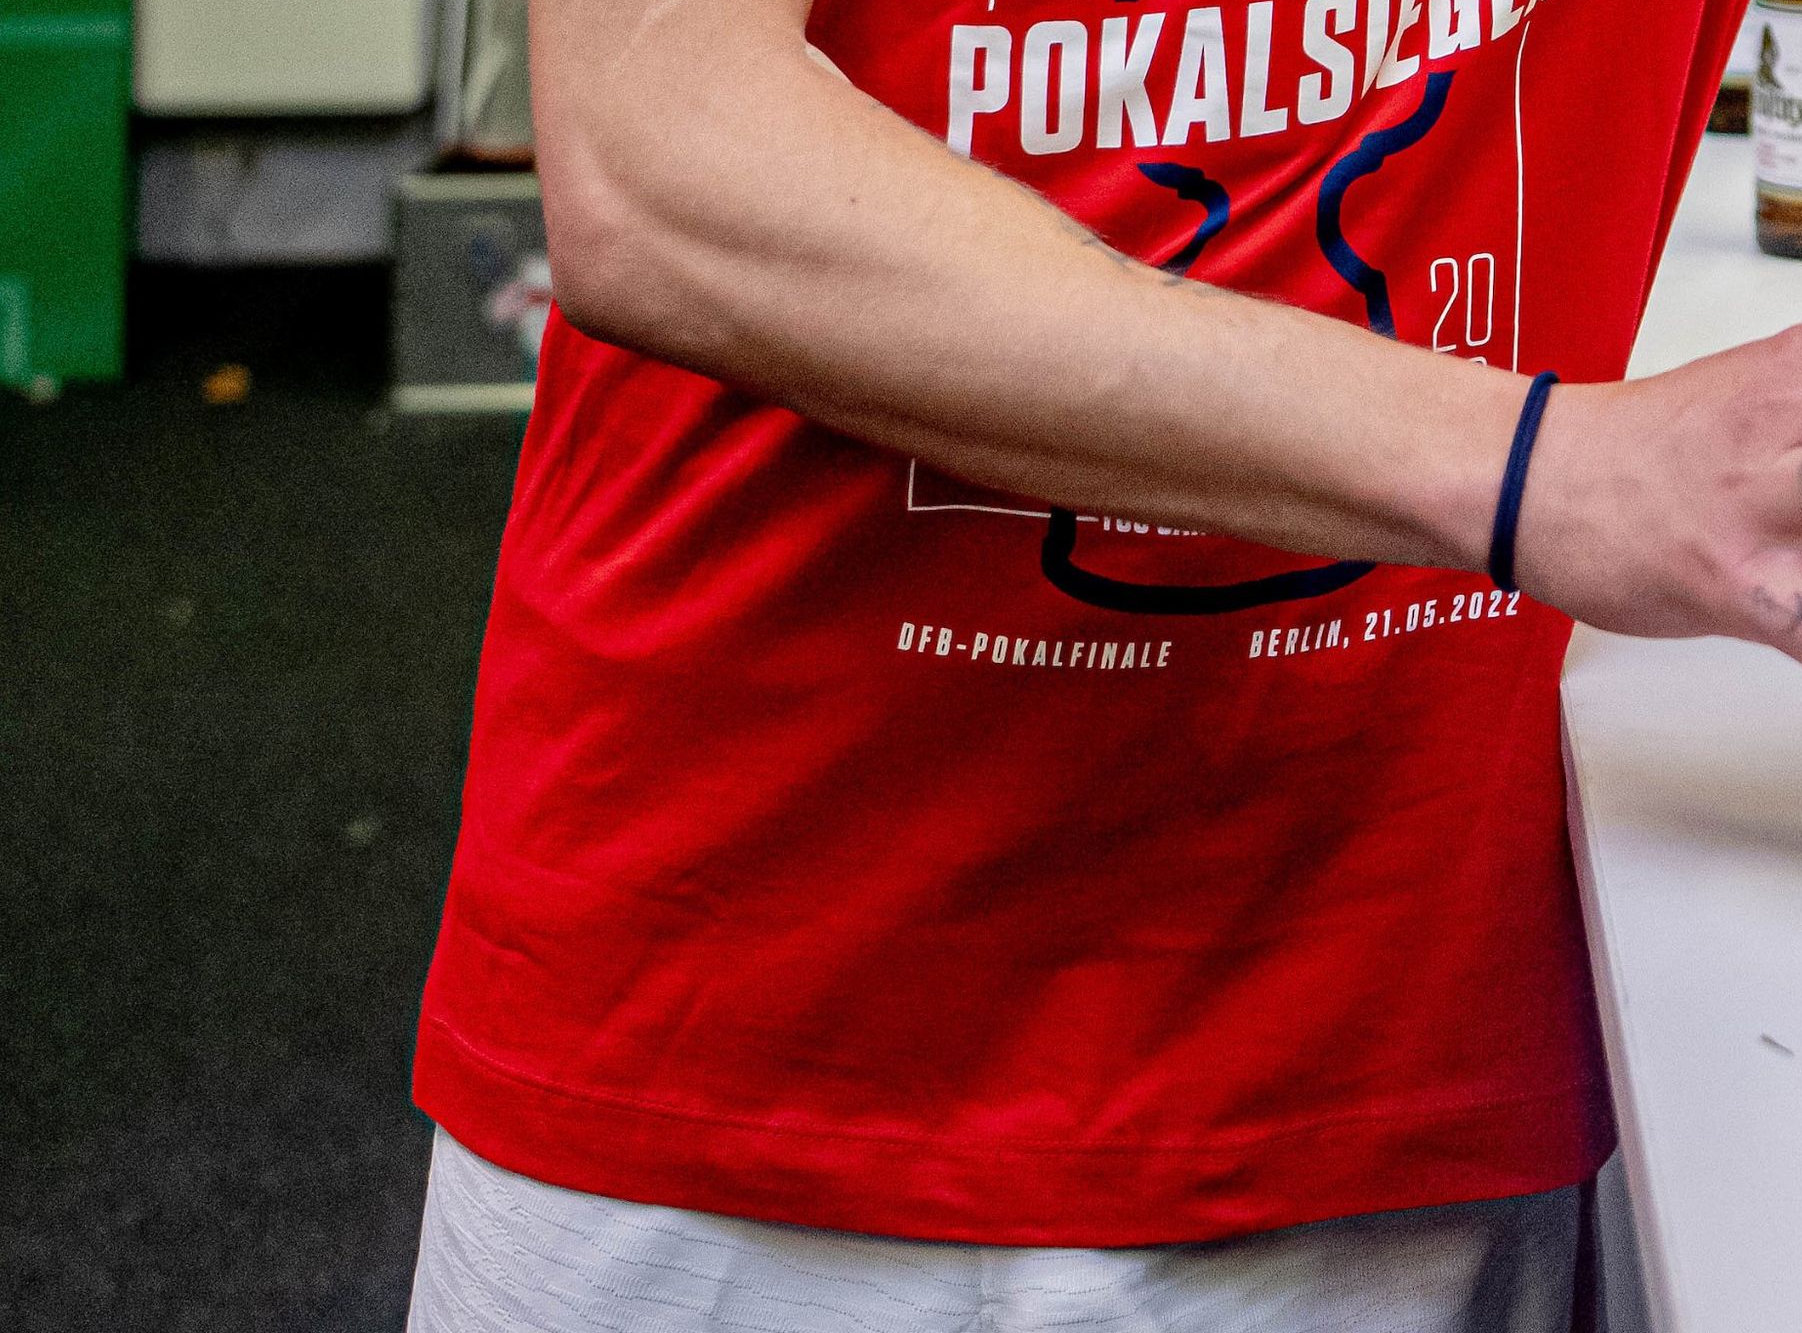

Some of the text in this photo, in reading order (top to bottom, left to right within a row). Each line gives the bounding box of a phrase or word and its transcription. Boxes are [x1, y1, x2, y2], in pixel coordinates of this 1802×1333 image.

[1429, 252, 1495, 353] 20
[897, 621, 1173, 670] DFB-POKALFINALE
[1248, 589, 1521, 659] BERLIN, 21.05.2022
